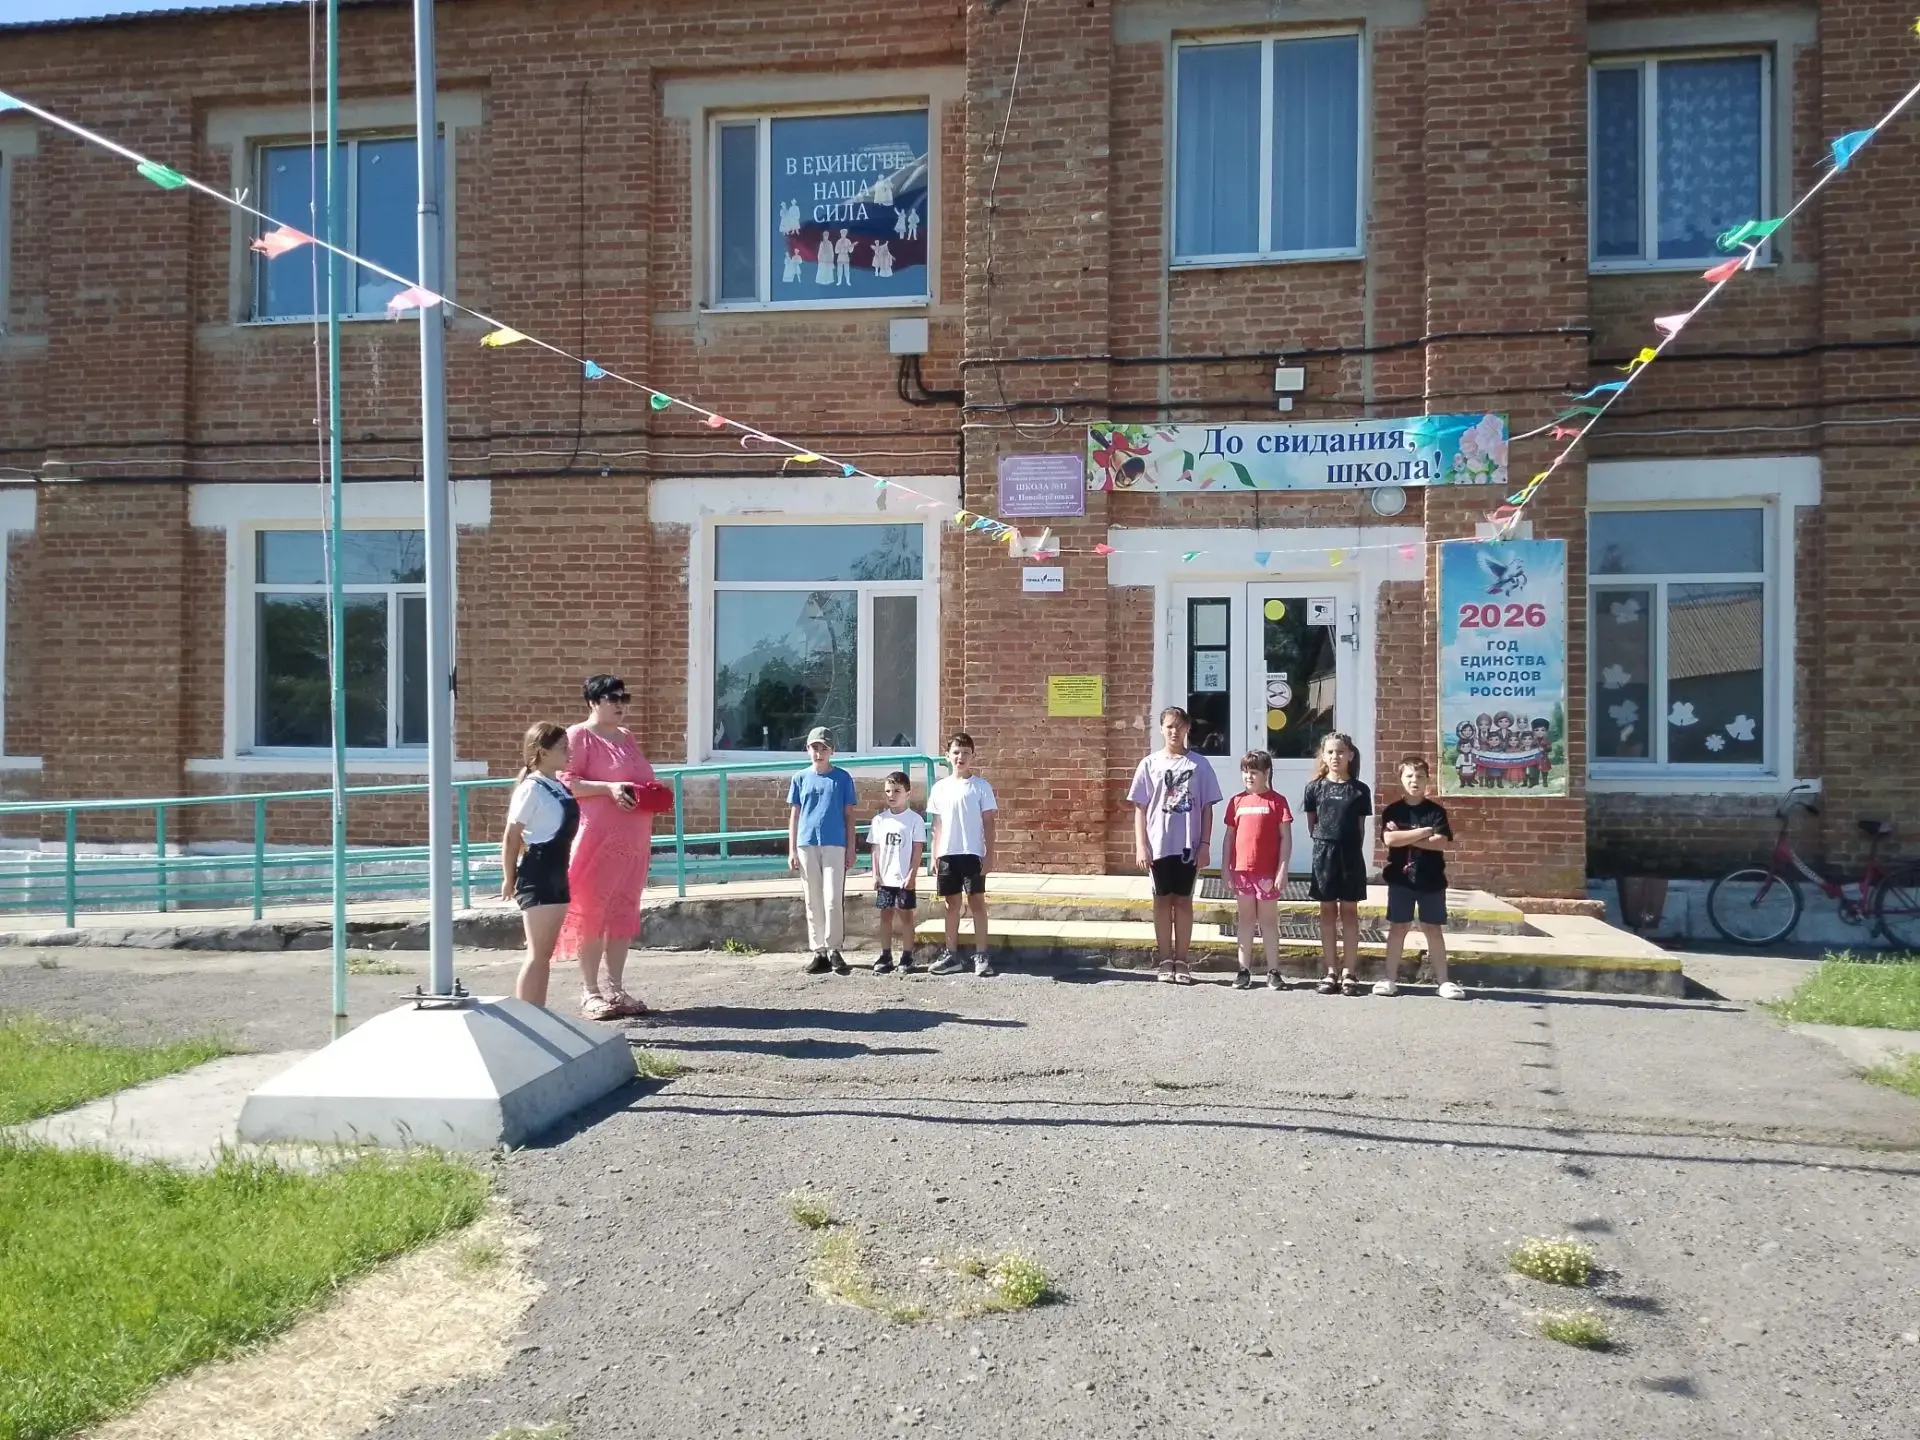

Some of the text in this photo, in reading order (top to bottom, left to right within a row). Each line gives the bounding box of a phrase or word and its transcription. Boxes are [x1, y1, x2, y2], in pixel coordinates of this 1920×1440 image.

[786, 152, 905, 176] В ЕДИНСТВЕ
[813, 179, 870, 201] НАША
[813, 203, 869, 223] СИЛА
[1199, 427, 1417, 460] До свидания,
[1326, 451, 1443, 484] школа!
[1015, 483, 1049, 491] ШКОЛА
[1459, 603, 1546, 629] 2026
[1487, 640, 1519, 653] ГОД
[1460, 655, 1546, 668] ЕДИНСТВА
[1464, 670, 1542, 683] НАРОДОВ
[1470, 686, 1536, 697] РОССИИ
